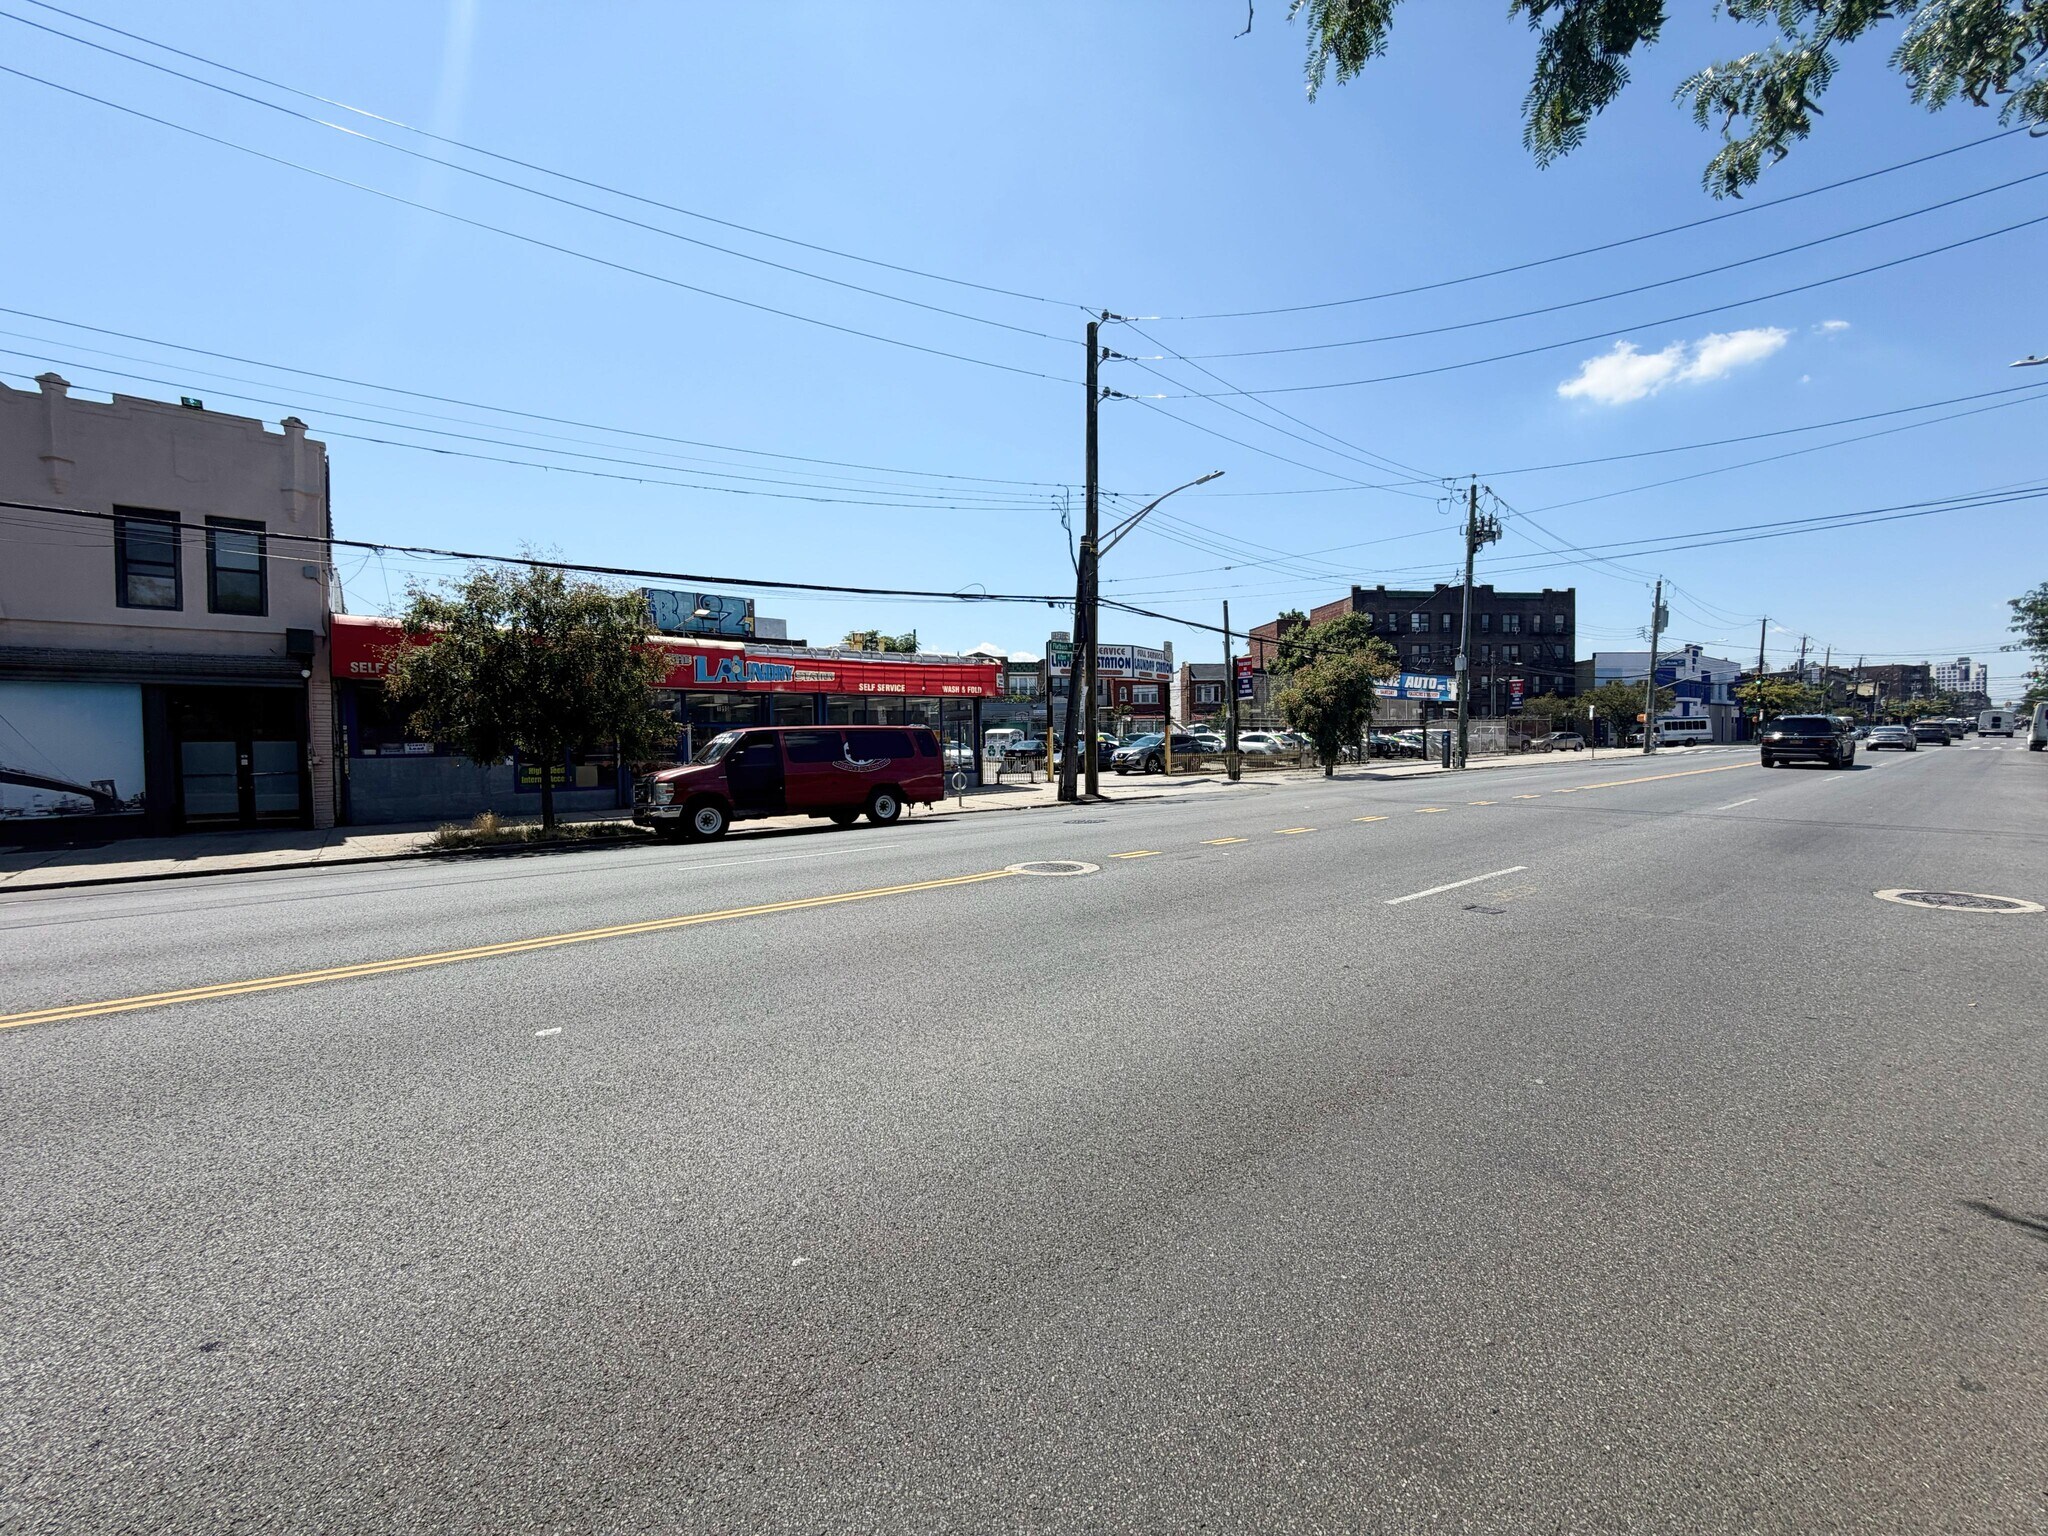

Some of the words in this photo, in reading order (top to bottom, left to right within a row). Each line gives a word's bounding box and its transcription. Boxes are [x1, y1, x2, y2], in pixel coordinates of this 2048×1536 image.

[1147, 651, 1163, 660] SERVICE
[350, 662, 384, 673] SELF
[693, 655, 796, 683] LAUNDRY
[1097, 657, 1131, 669] STATION
[1134, 658, 1155, 671] LAUNDRY
[1156, 661, 1173, 674] STATION
[859, 683, 876, 692] SELF
[877, 684, 905, 692] SERVICE
[942, 685, 960, 693] WASH
[967, 686, 982, 694] FOLD
[1405, 676, 1437, 689] AUTO
